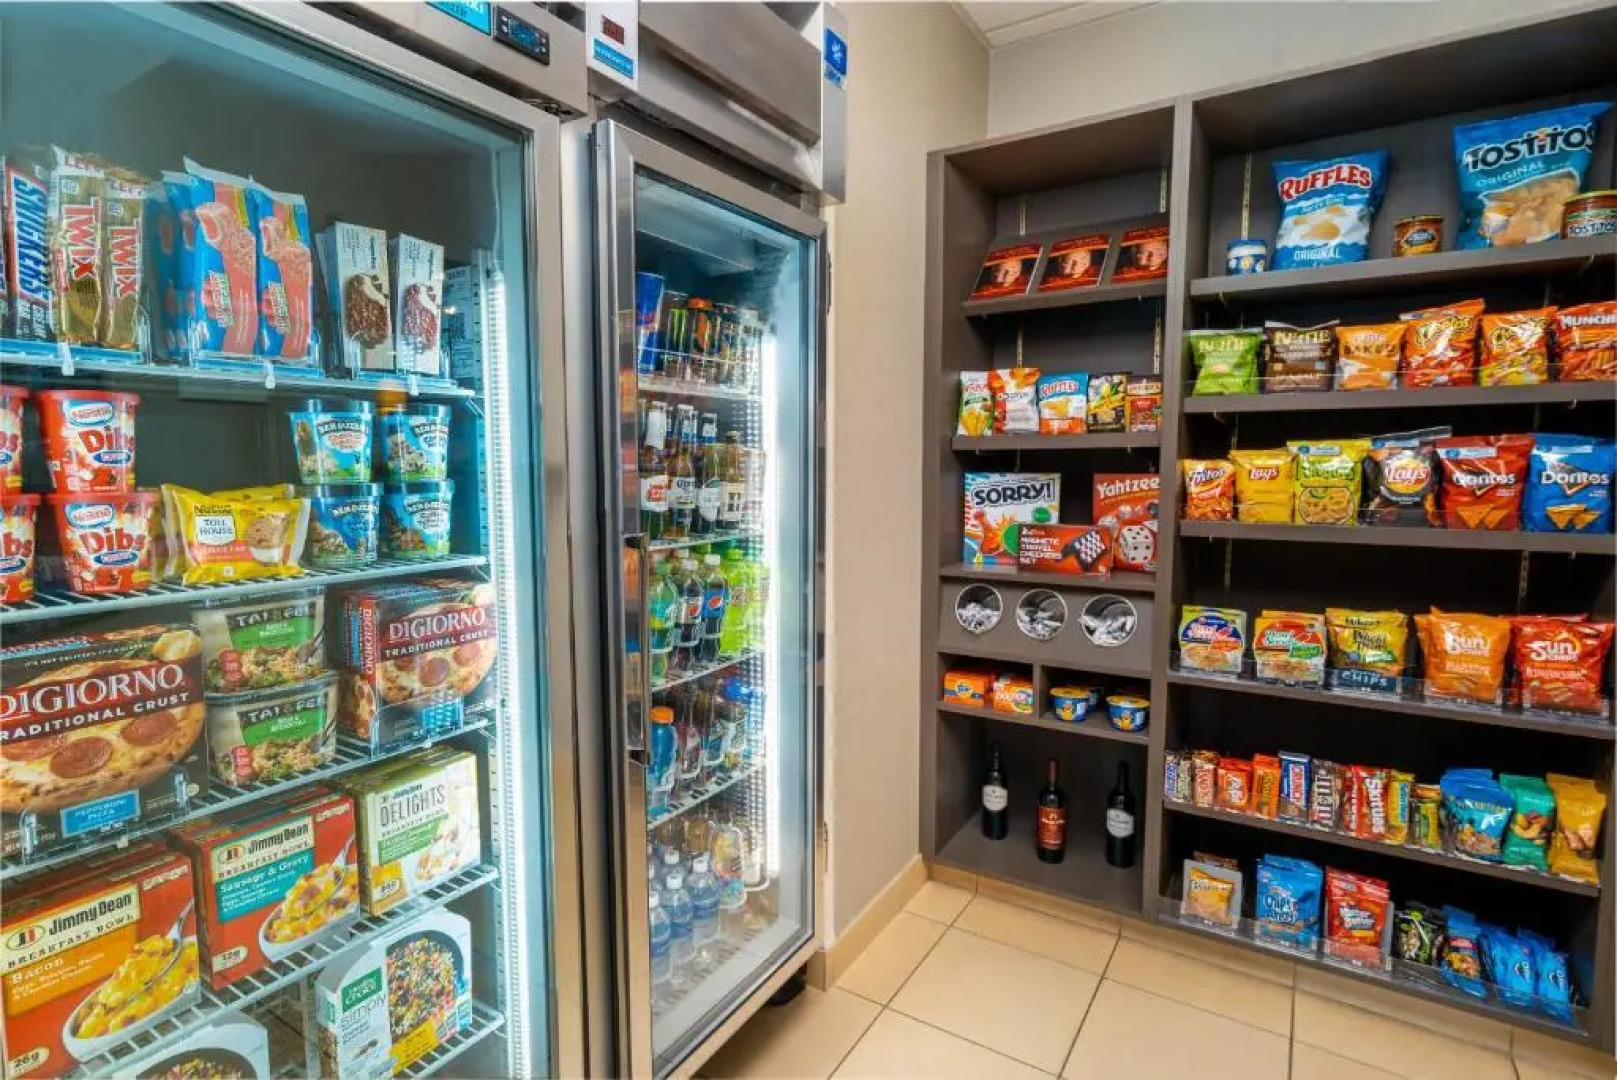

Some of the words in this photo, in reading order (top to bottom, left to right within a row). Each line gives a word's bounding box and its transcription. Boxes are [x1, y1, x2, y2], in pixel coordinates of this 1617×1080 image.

[1279, 163, 1372, 200] RUFFLES
[13, 176, 49, 301] SNICKERS
[62, 197, 101, 281] TWIX
[108, 217, 141, 300] TWIX
[974, 481, 1052, 507] SORRY!
[1541, 470, 1609, 485] Doritos
[78, 527, 146, 551] Dibs
[237, 611, 269, 627] TAI
[389, 608, 486, 642] DIGIORNO
[385, 637, 457, 658] TRADITIONAL
[0, 709, 125, 741] RADITIONAL
[133, 692, 189, 710] CRUST
[248, 708, 281, 723] TAI
[381, 785, 444, 827] DELIGHTS
[8, 931, 92, 969] BREAKFAST
[96, 913, 134, 935] BOWL
